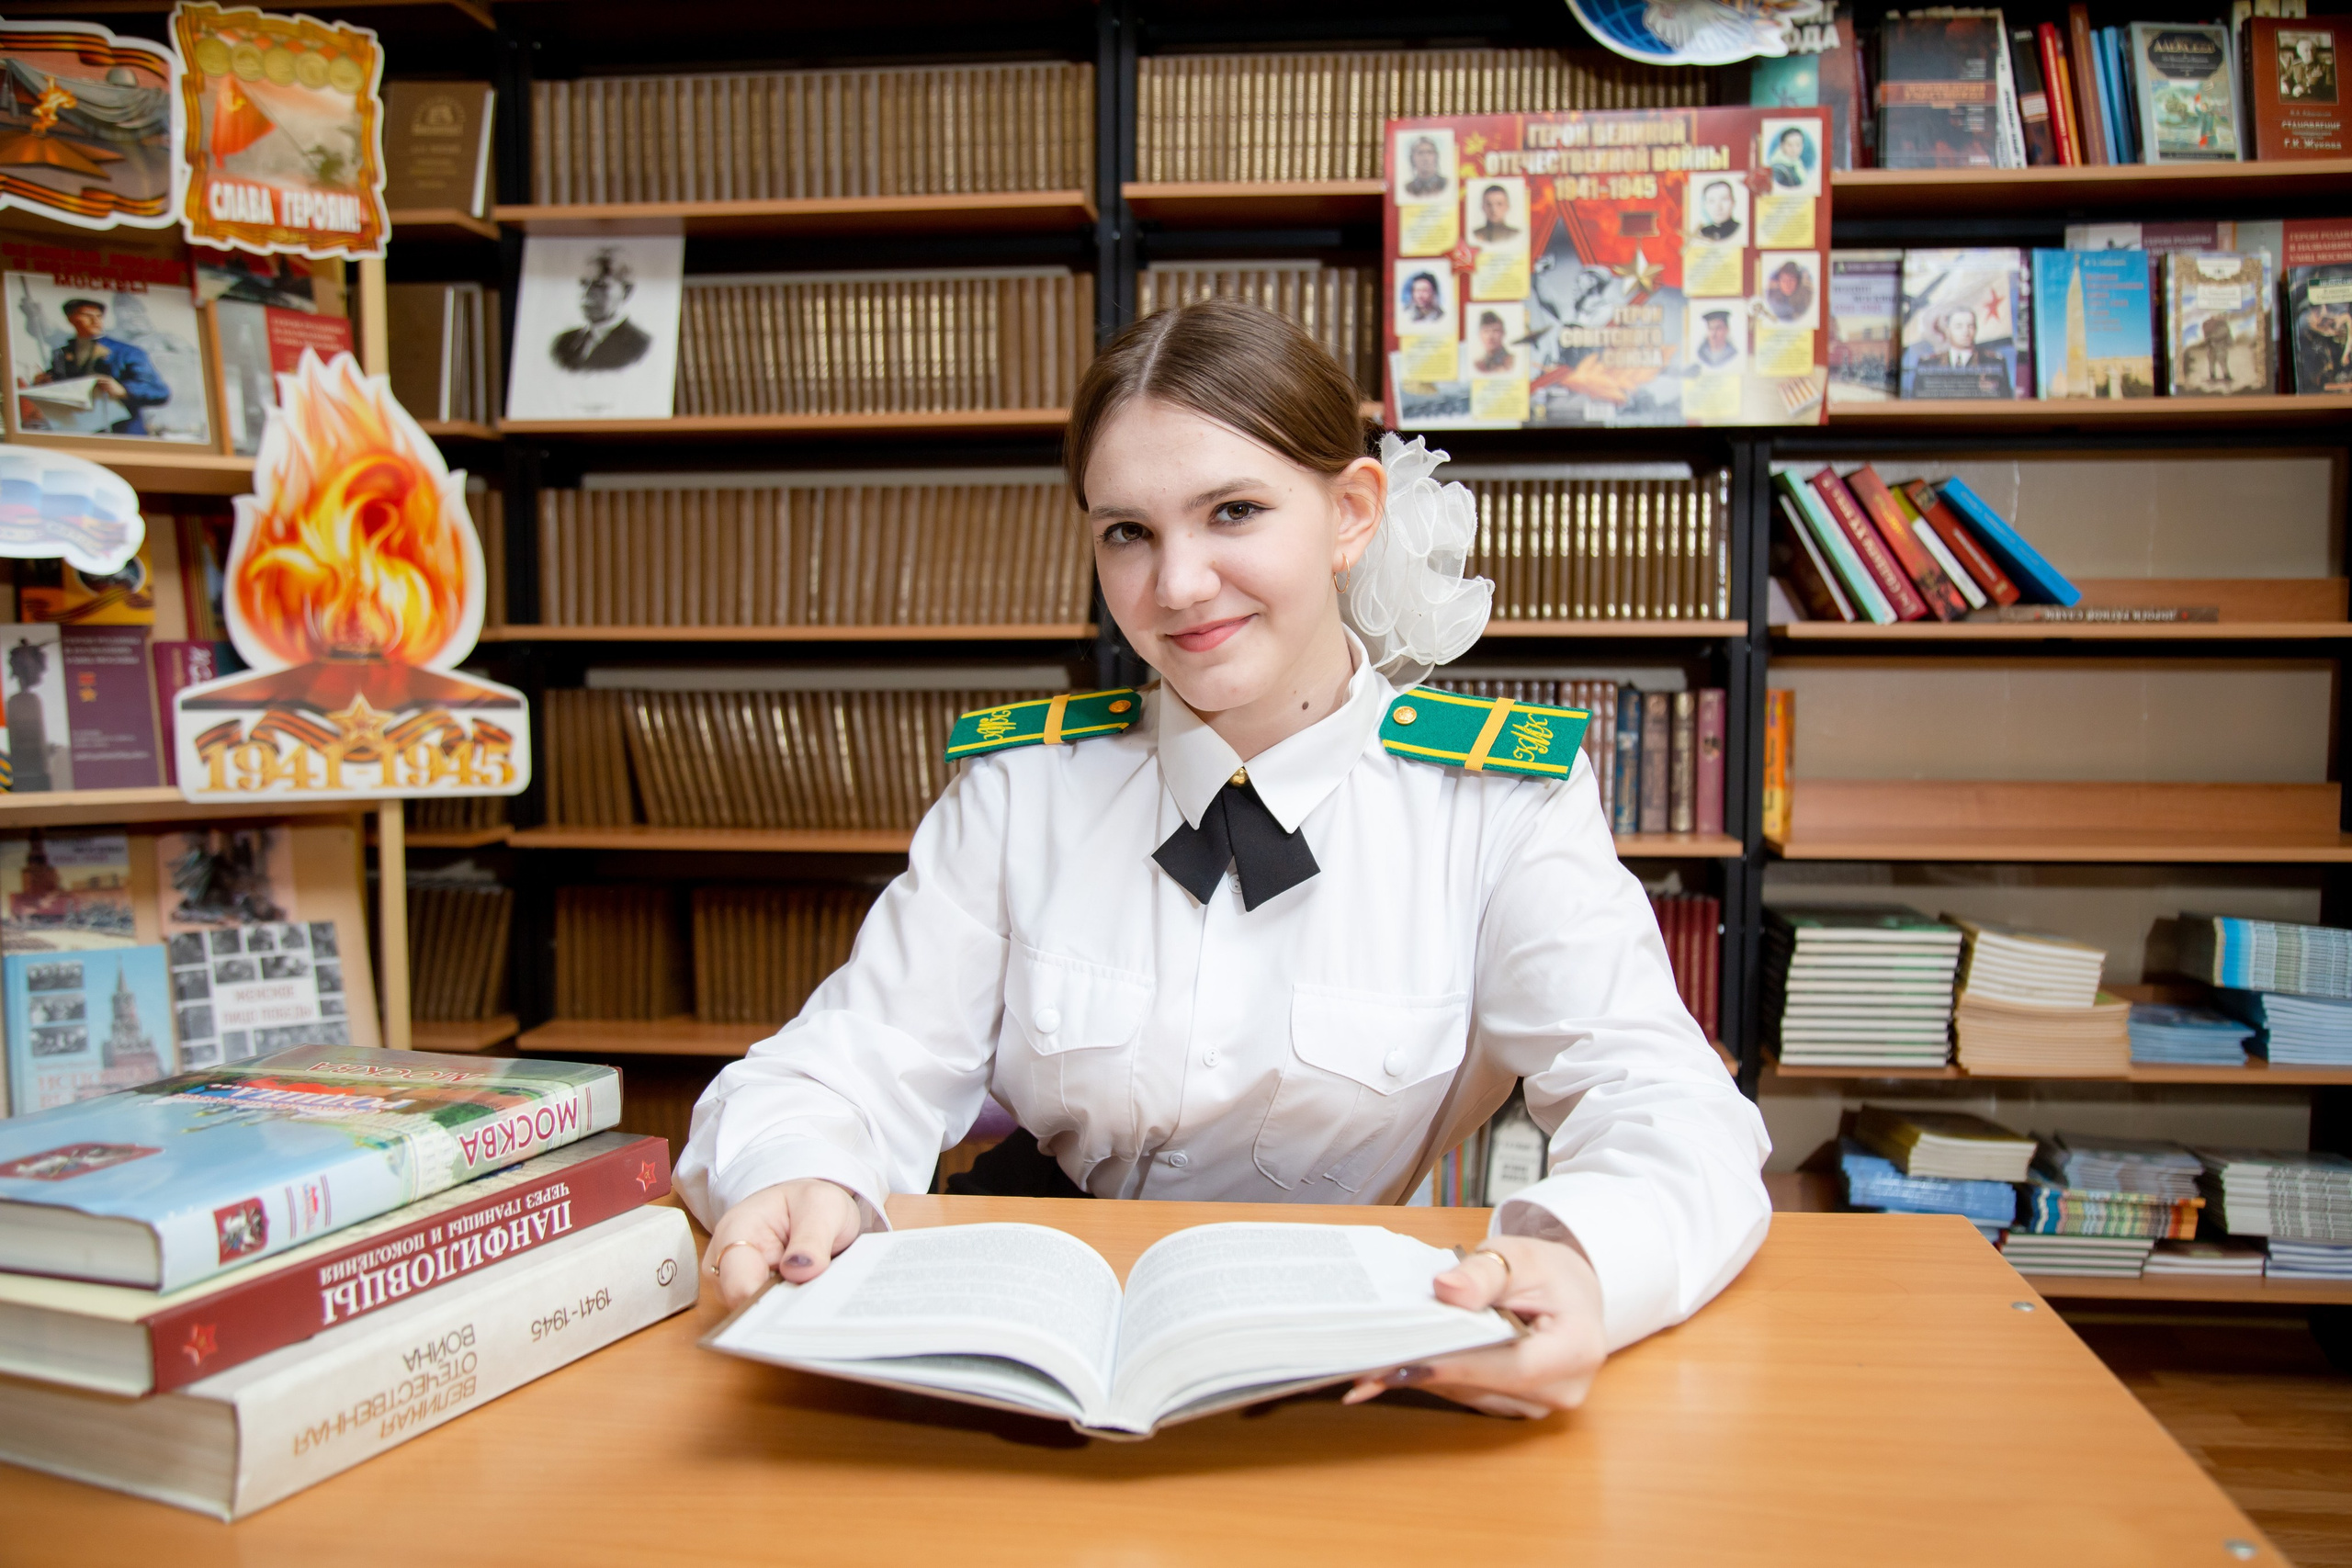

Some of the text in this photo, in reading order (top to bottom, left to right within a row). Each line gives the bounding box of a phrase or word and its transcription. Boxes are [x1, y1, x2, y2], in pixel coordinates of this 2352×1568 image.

[1526, 118, 1686, 146] ГЕРОИ ВЕЛИКОЙ
[2303, 139, 2343, 152] Жукова
[1485, 145, 1730, 175] ОТЕЧЕСТВЕННОЙ ВОЙНЫ
[209, 180, 362, 234] СЛАВА ГЕРОЯМ!
[1554, 175, 1658, 200] 1941-1945
[1559, 325, 1664, 349] СОВЕТСКОГО
[1613, 305, 1664, 326] ГЕРОИ
[1600, 347, 1664, 368] СОЮЗА
[196, 740, 519, 794] 1941-1945
[307, 1060, 484, 1082] МОСКВА
[458, 1096, 579, 1169] МОСКВА
[320, 1181, 571, 1285] ЧЕРЕЗ ГРАНИЦЫ И ПОКОЛЕНИЯ
[322, 1200, 574, 1324] ПАНФИЛОВЦЫ
[530, 1286, 612, 1342] 1941-1945
[403, 1324, 476, 1370] ВОЙНА
[293, 1351, 479, 1457] ОТЕЧЕСТВЕННАЯ
[380, 1371, 479, 1439] ВЕЛИКАЯ
